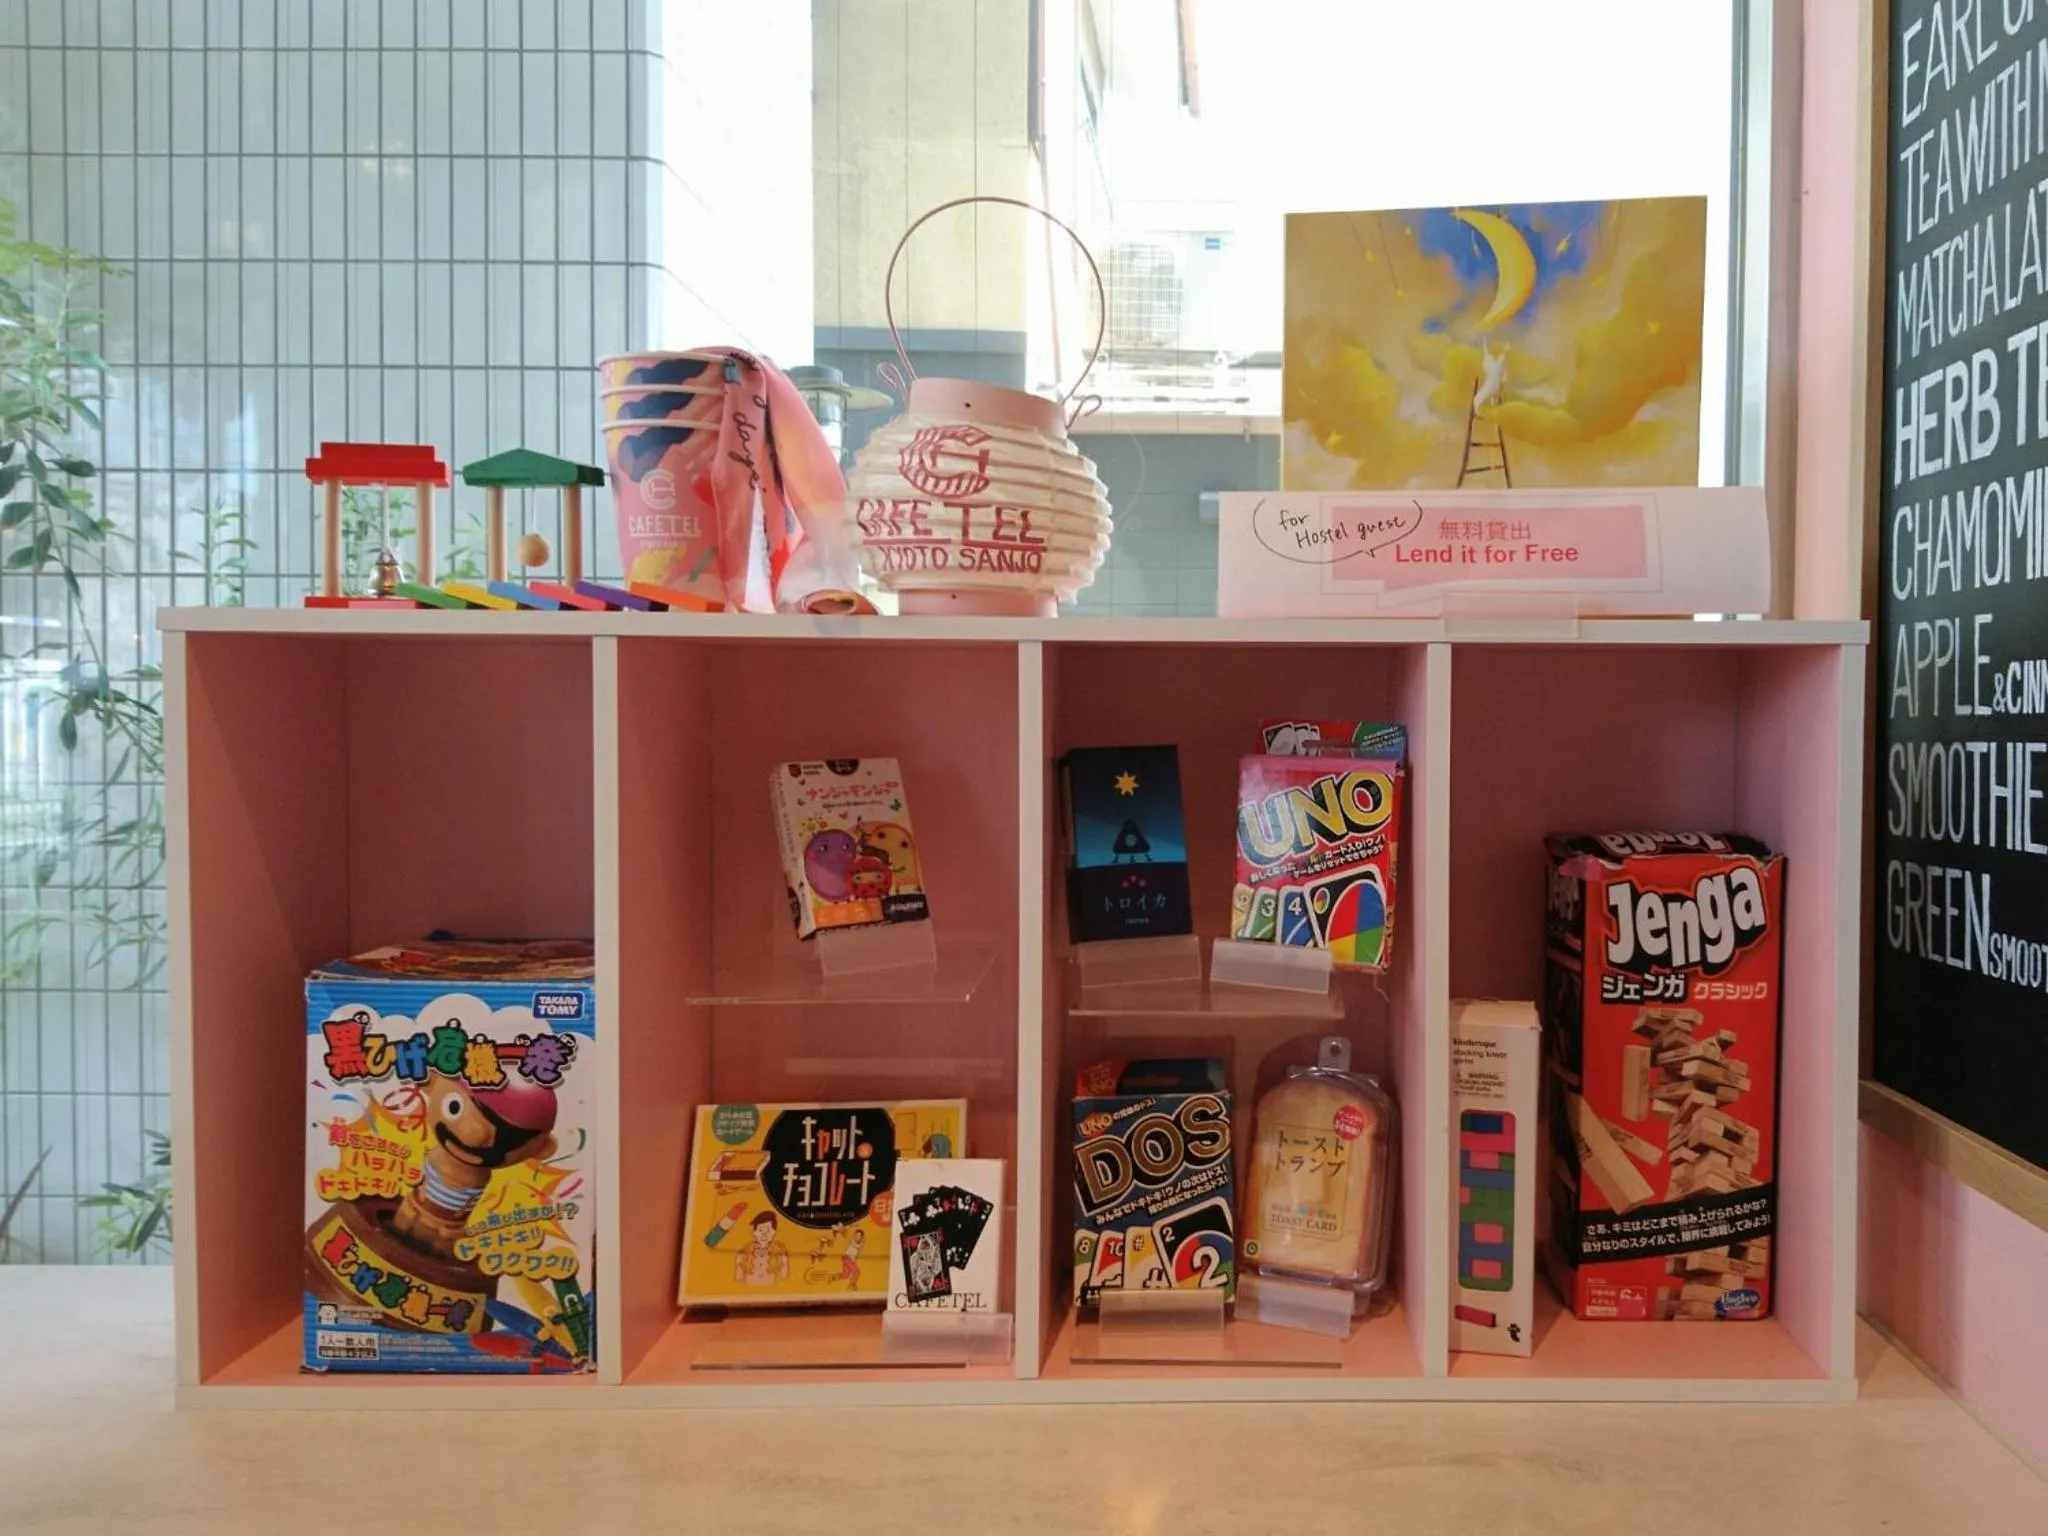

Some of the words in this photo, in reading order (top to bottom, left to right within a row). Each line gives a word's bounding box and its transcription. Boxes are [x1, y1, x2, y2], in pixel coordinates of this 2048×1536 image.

[1902, 0, 1998, 128] EARL
[1897, 214, 1999, 368] MATCHA
[1895, 348, 2000, 486] HERB
[1279, 509, 1309, 530] for
[1437, 519, 1532, 541] 無料貸出
[1295, 522, 1349, 548] Hostel
[1395, 544, 1452, 564] Lend
[1460, 544, 1477, 563] it
[1484, 543, 1518, 563] for
[1525, 543, 1579, 563] Free
[1890, 613, 1993, 719] APPLE
[1888, 741, 2048, 855] SMOOTHIE
[1239, 770, 1394, 861] UNO
[1104, 893, 1166, 913] トロイカ
[1261, 899, 1275, 917] 3
[1288, 897, 1302, 916] 4
[1607, 866, 1765, 968] Jenga
[1886, 860, 1990, 975] GREEN
[1602, 973, 1685, 1000] ジェンガ
[1694, 982, 1768, 1000] クラシック
[538, 1004, 577, 1015] TOMY
[539, 996, 578, 1005] TAKARA
[801, 1115, 863, 1161] キャット
[1075, 1095, 1230, 1208] DOS
[1277, 1130, 1344, 1156] トースト
[352, 1151, 422, 1181] ハラハラ
[1274, 1152, 1346, 1178] トランプ
[783, 1161, 876, 1207] チョコレート
[1162, 1227, 1175, 1242] 2
[1306, 1219, 1338, 1232] CARD
[1193, 1245, 1228, 1289] 2
